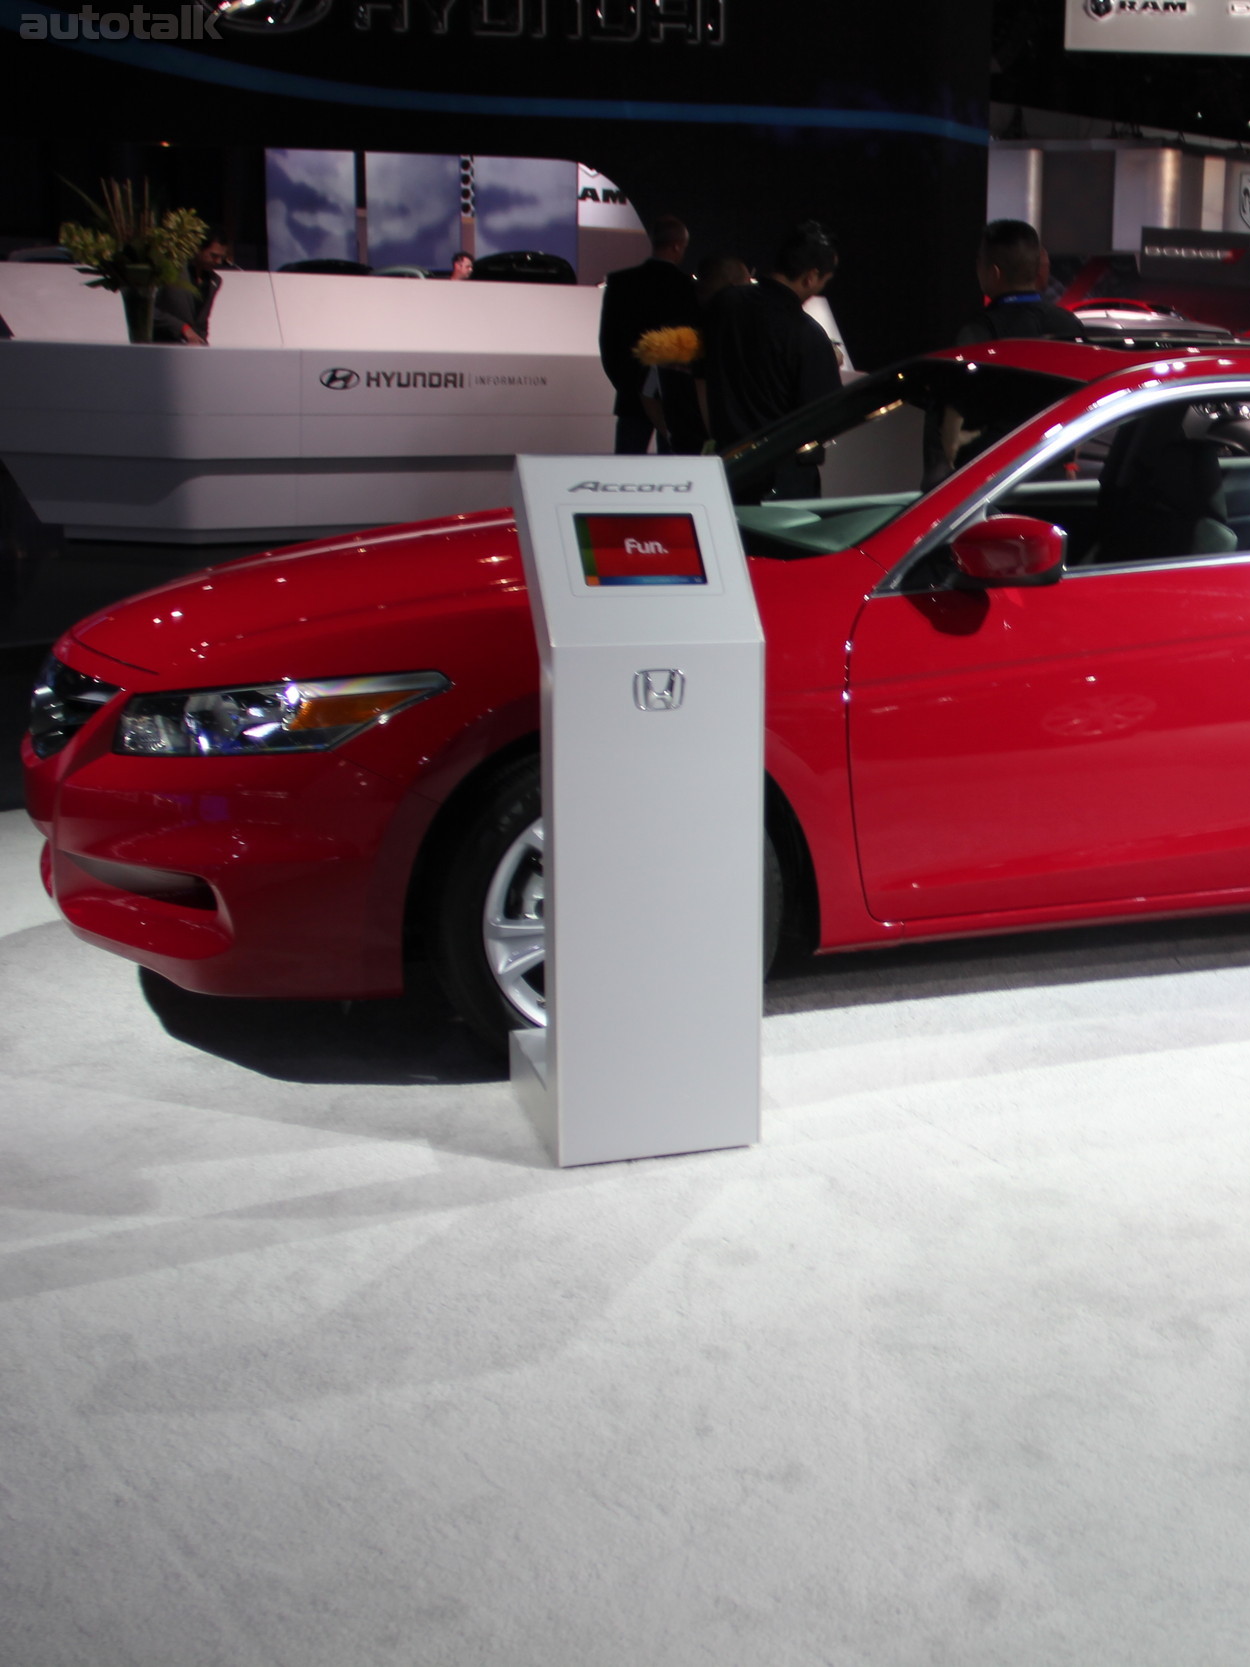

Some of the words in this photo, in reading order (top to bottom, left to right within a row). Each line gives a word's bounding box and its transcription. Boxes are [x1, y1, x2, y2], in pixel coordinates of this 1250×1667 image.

[1118, 0, 1187, 12] RAM
[577, 186, 628, 206] AM
[1144, 245, 1233, 260] DODGE
[365, 370, 465, 389] HYUNDAI
[475, 374, 548, 387] INFORMATION
[567, 480, 694, 494] Accord
[623, 537, 670, 555] Fun.
